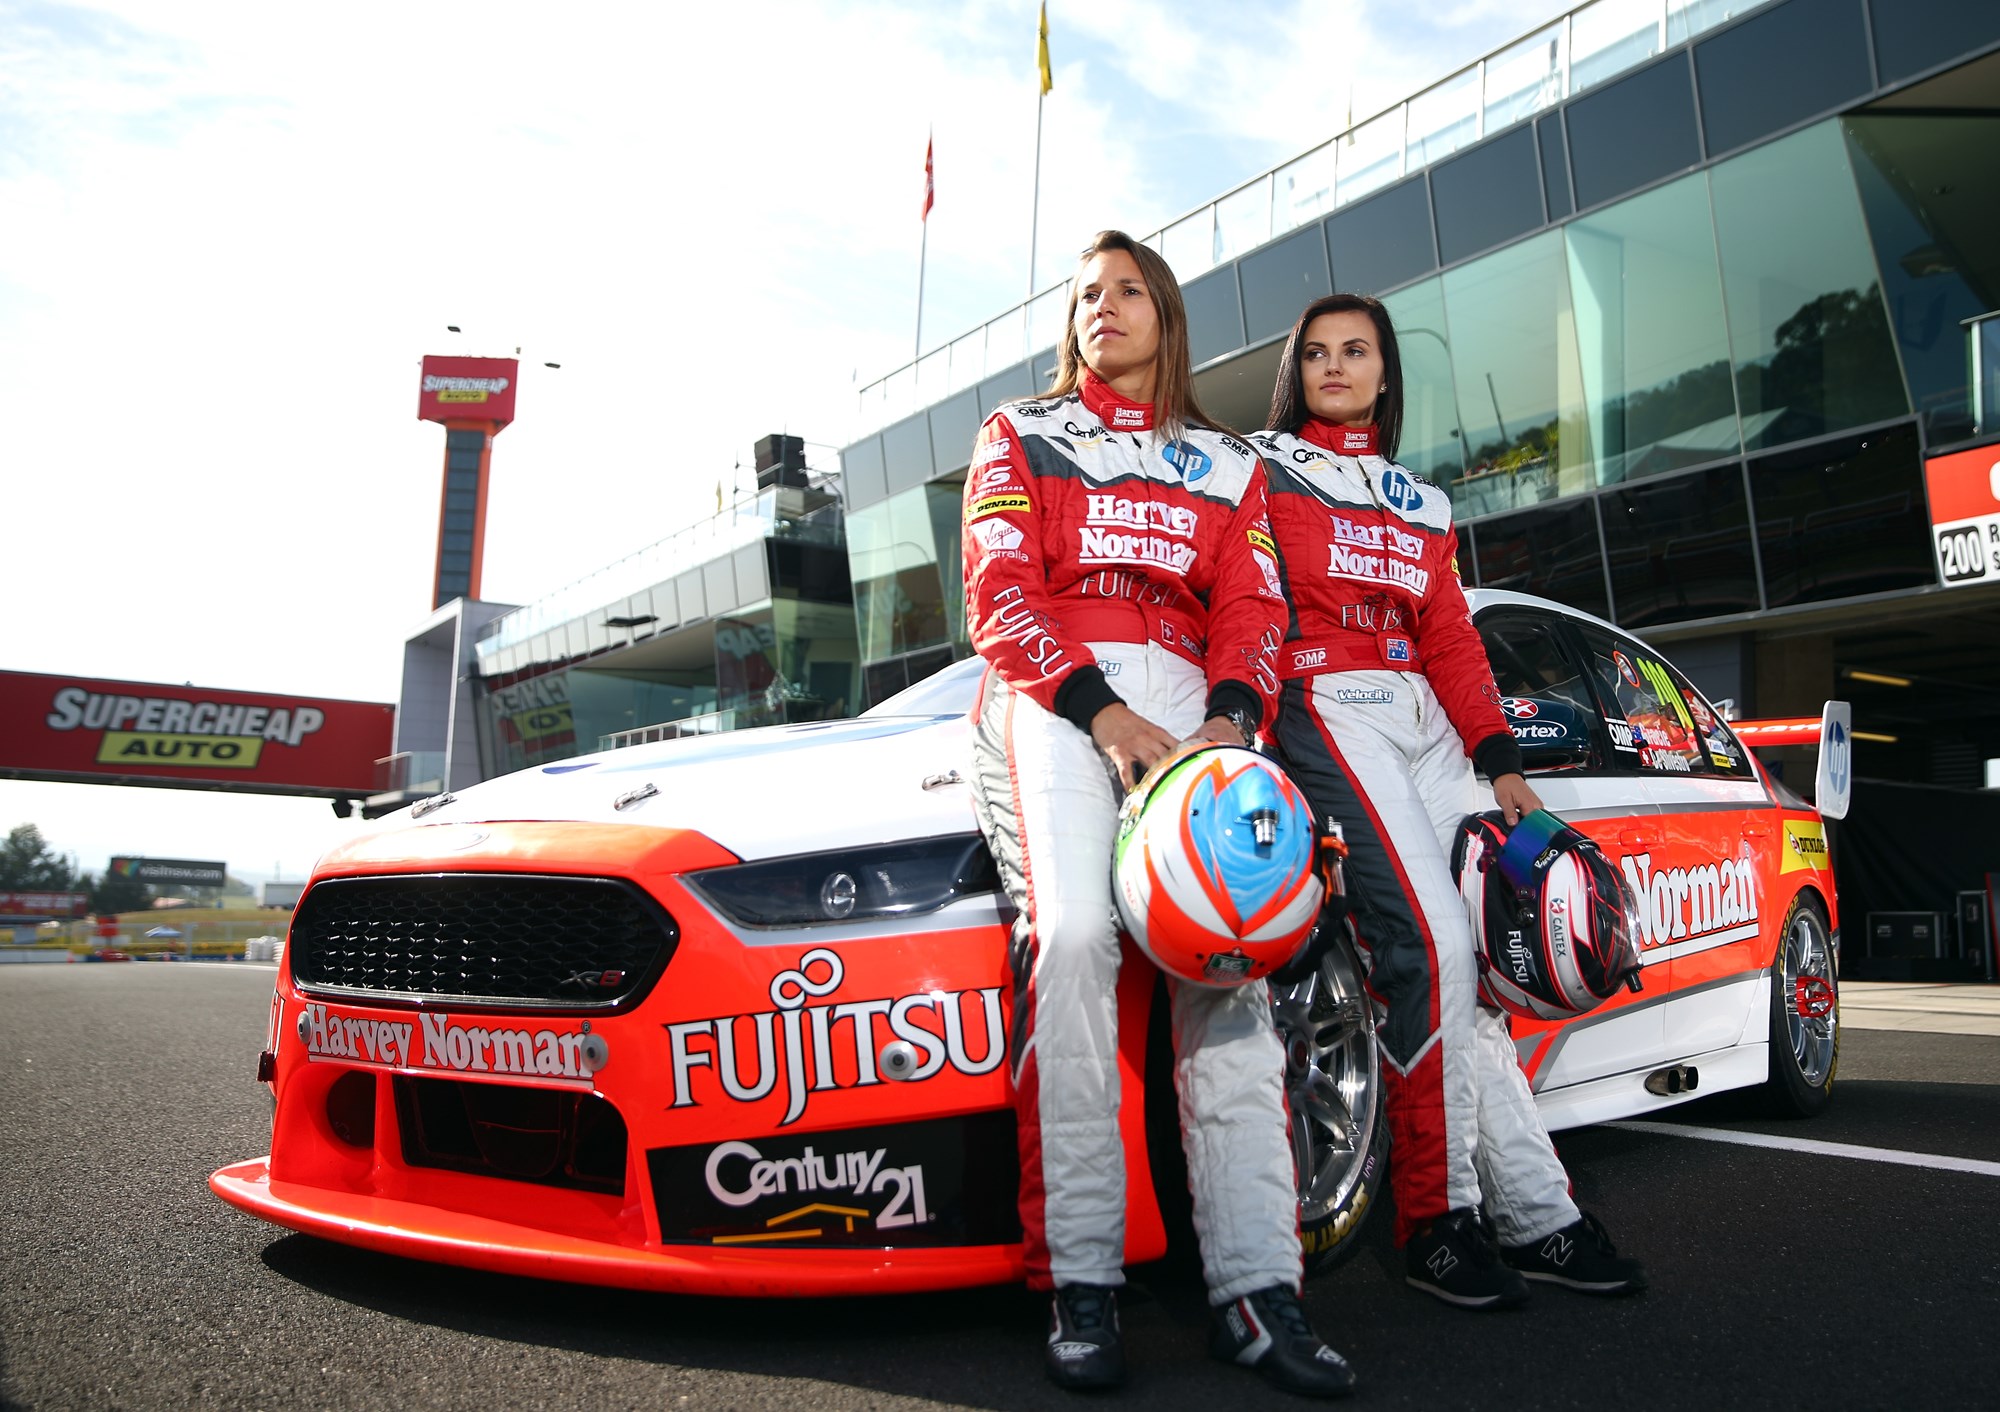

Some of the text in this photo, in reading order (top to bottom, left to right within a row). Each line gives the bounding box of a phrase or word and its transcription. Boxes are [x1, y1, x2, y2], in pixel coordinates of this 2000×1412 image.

[423, 376, 508, 394] SUPERCHEAP
[1112, 416, 1144, 426] Norman
[1115, 407, 1144, 419] Harvey
[1221, 436, 1249, 457] OMP
[976, 500, 1028, 513] DUNLOP
[1388, 470, 1417, 511] hp
[985, 523, 1016, 547] Virgin
[1086, 494, 1198, 539] Harvey
[1329, 514, 1424, 560] Harvey
[1078, 527, 1197, 573] Norman
[1327, 543, 1429, 593] Norman
[1940, 530, 1984, 578] 200
[993, 584, 1073, 678] FUJITSU
[1294, 650, 1326, 667] OMP
[48, 687, 324, 746] SUPERCHEAP
[1337, 689, 1393, 703] Velocity
[120, 738, 241, 759] AUTO
[1509, 723, 1558, 738] ortex
[1608, 723, 1633, 747] OMP
[1829, 721, 1847, 796] hp
[1799, 837, 1826, 853] DUNLOP
[140, 864, 222, 880] visitnsw.com
[1621, 855, 1758, 945] Norman
[1508, 928, 1529, 984] FUJITSU
[1553, 918, 1567, 957] CALTEX
[304, 1003, 413, 1067] Harvey
[418, 1012, 594, 1078] Norman
[662, 985, 1007, 1128] FUJITSU
[704, 1140, 928, 1231] Century 21
